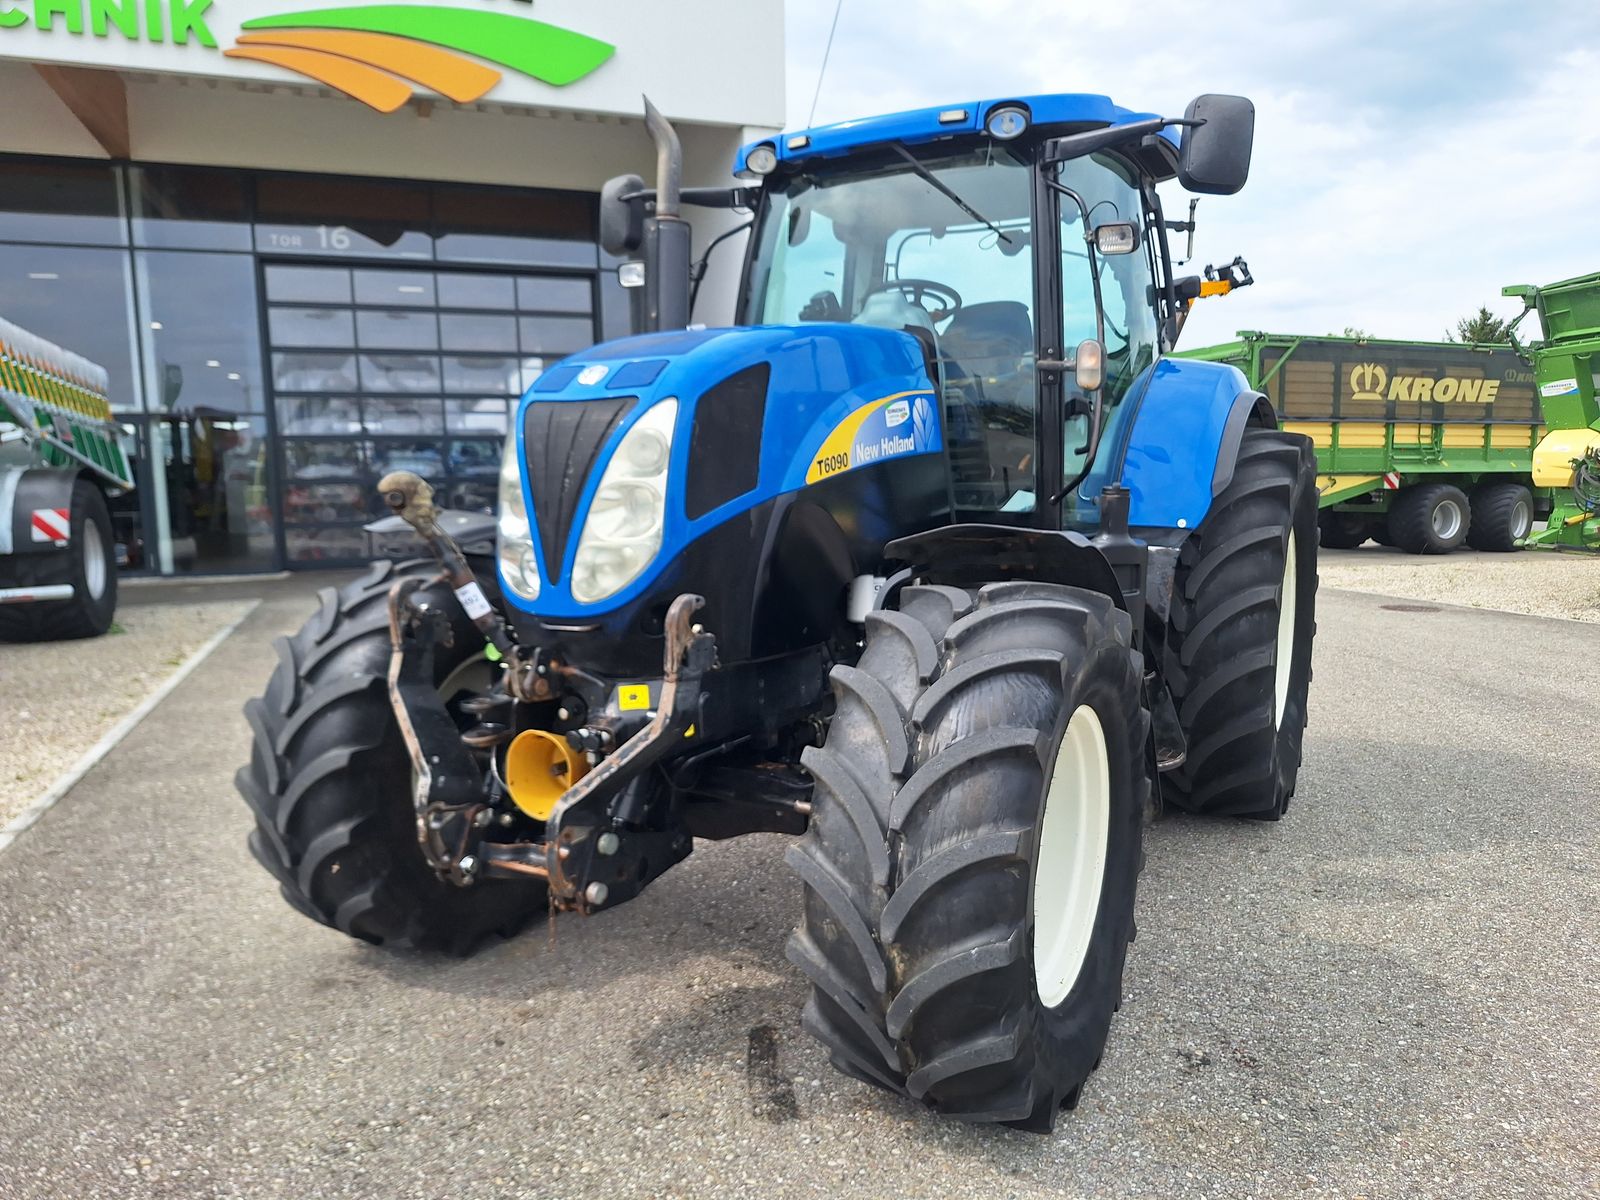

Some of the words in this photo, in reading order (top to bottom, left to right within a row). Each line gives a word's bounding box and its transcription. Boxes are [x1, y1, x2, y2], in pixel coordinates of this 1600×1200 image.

[270, 233, 301, 247] TOR
[317, 224, 350, 250] 16
[1387, 376, 1500, 403] KRONE
[855, 442, 879, 463] New
[881, 433, 914, 457] Holland
[816, 452, 849, 476] T6090
